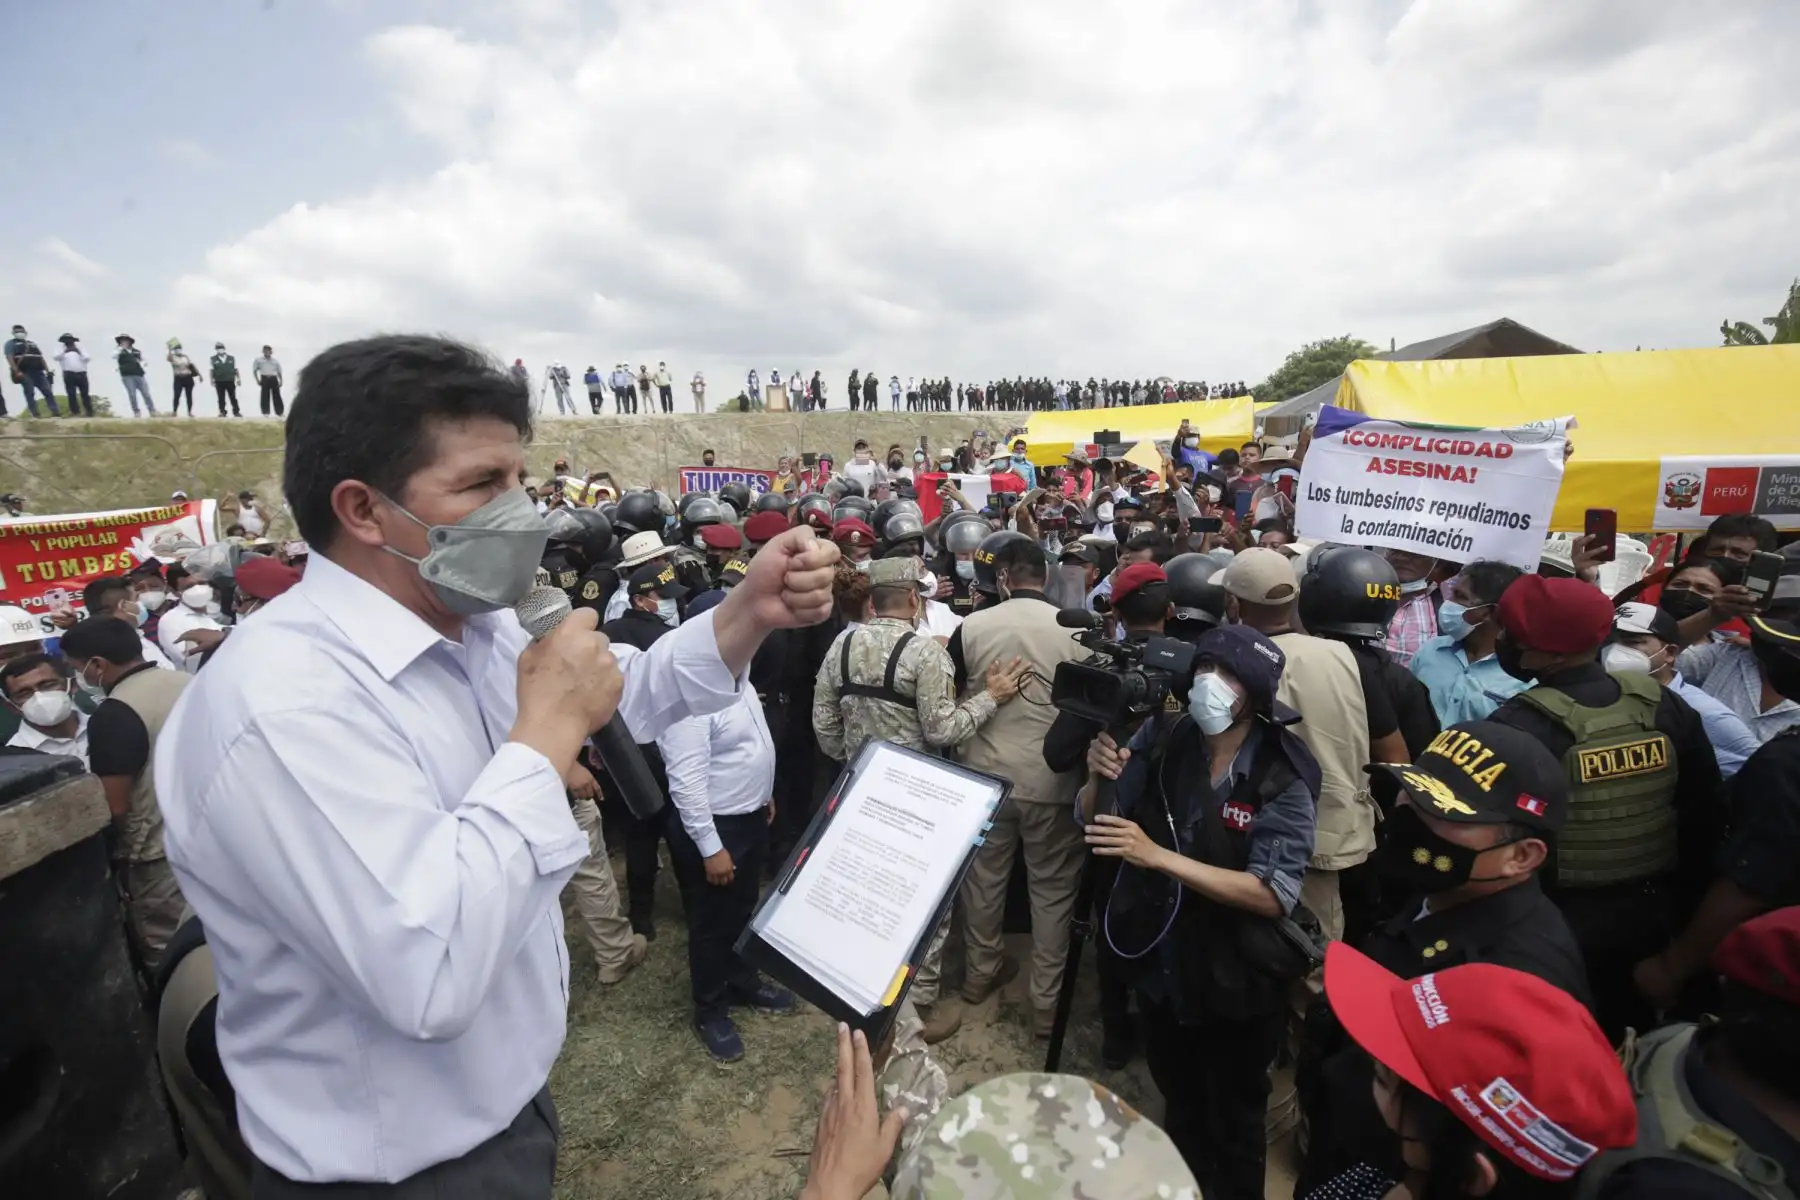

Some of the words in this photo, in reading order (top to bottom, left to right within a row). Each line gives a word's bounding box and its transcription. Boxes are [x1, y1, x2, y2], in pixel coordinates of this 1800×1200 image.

[1343, 430, 1514, 460] ¡COMPLICIDAD
[1366, 456, 1479, 484] ASESINA!
[1713, 485, 1748, 497] PERÚ
[1768, 485, 1786, 495] de
[1308, 482, 1331, 503] Los
[1335, 486, 1425, 512] tumbesinos
[1429, 499, 1532, 531] repudiamos
[30, 539, 40, 552] Y
[46, 531, 119, 551] POPULAR
[1340, 514, 1353, 533] la
[1357, 519, 1473, 552] contaminación
[16, 551, 132, 583] TUMBES
[1584, 743, 1664, 777] POLICIA
[1222, 802, 1252, 827] irtp
